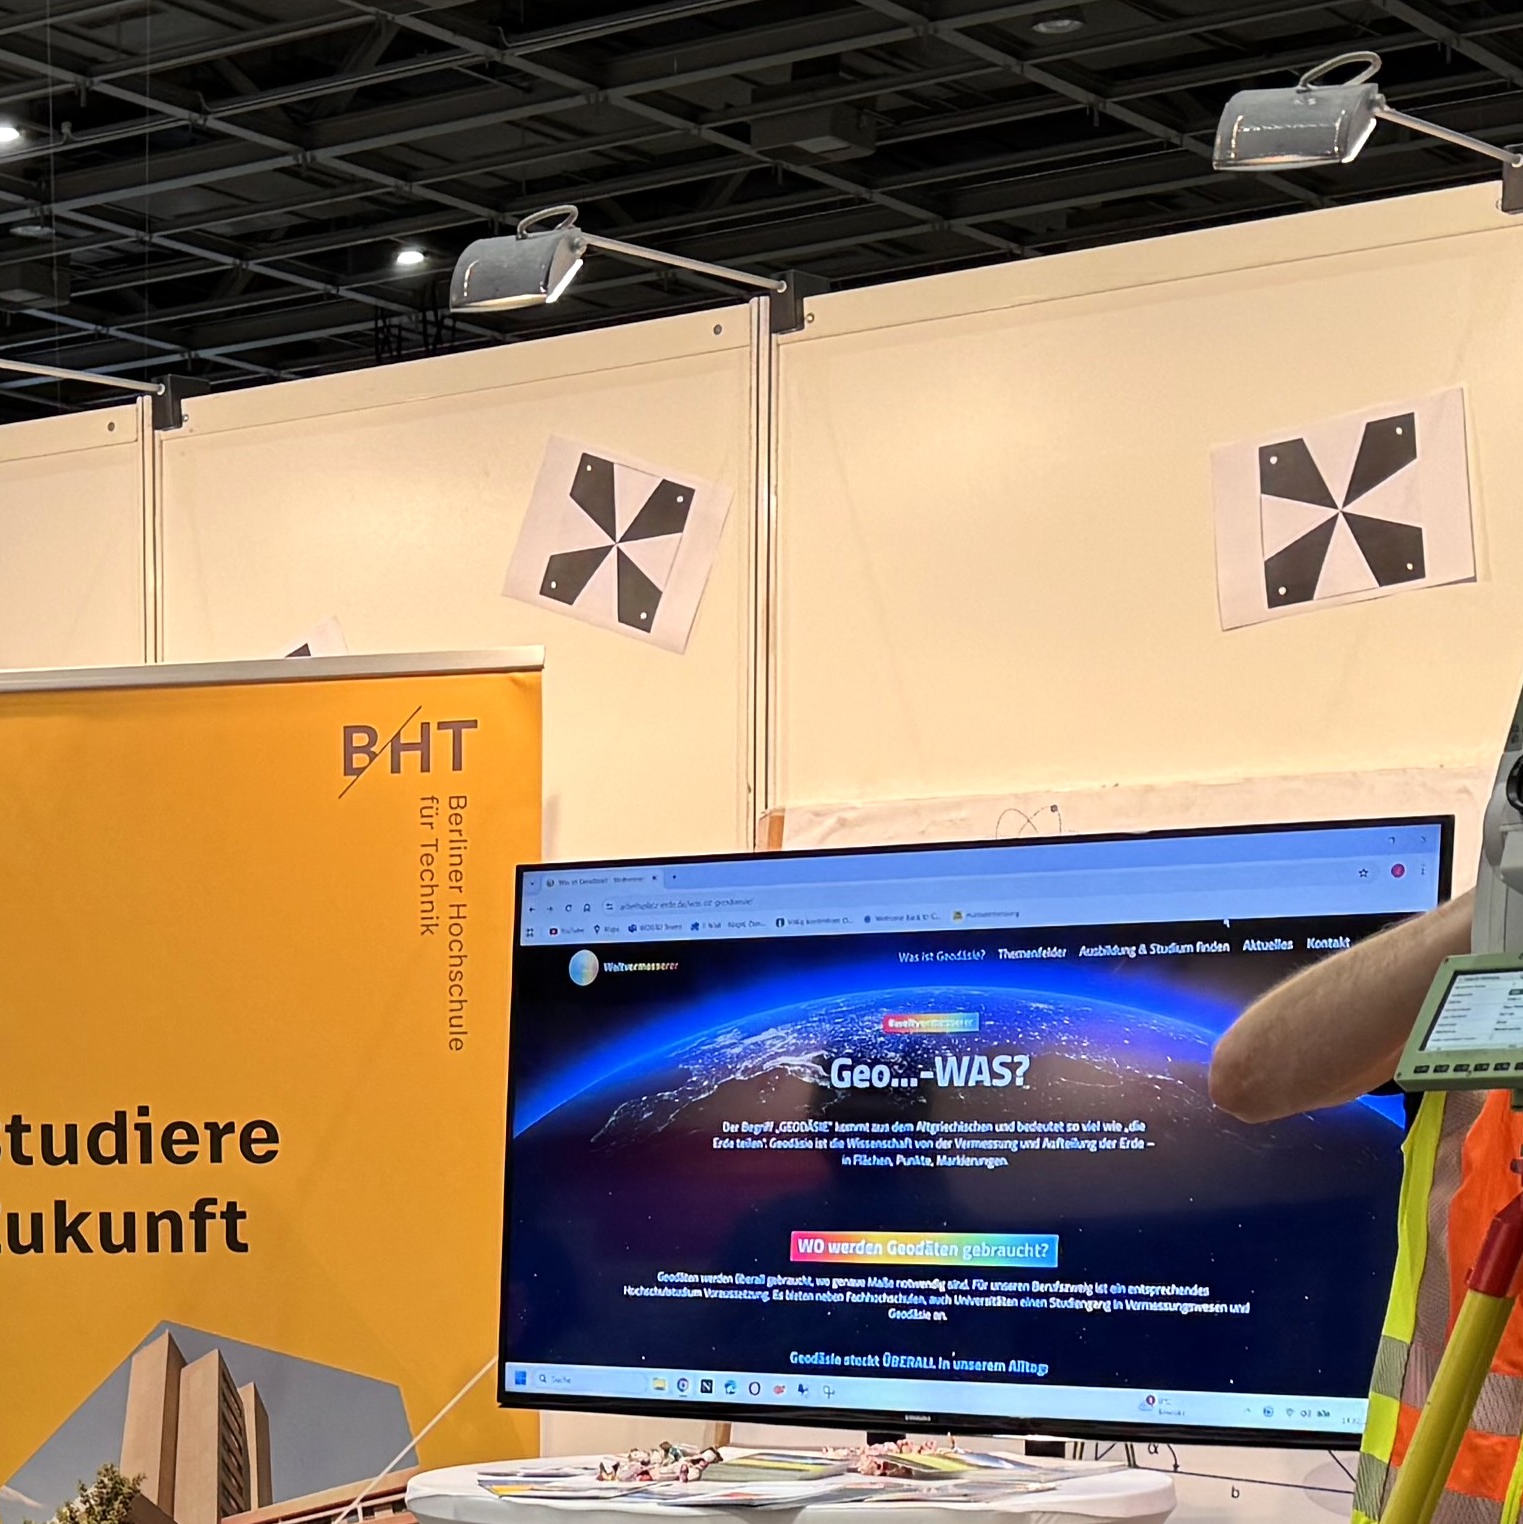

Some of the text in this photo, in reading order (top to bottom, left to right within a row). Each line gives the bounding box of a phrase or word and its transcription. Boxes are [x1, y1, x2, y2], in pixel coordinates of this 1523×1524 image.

[419, 794, 440, 937] für Technik
[447, 794, 469, 1052] Berliner Hochschule
[898, 951, 920, 963] Was
[921, 951, 935, 963] ist
[997, 946, 1067, 960] Themenfelder
[1078, 943, 1137, 959] Ausbildung
[1149, 942, 1195, 956] Studium
[1195, 941, 1231, 954] finden
[1241, 937, 1294, 952] Aktuelles
[1306, 935, 1351, 950] Kontakt
[722, 1121, 740, 1133] Der
[891, 1121, 915, 1133] dem
[994, 1121, 1016, 1133] und
[1016, 1121, 1065, 1133] bedeutet
[1066, 1123, 1080, 1133] so
[1081, 1121, 1101, 1133] viel
[1102, 1121, 1123, 1133] wie
[712, 1137, 735, 1149] Erde
[814, 1138, 828, 1149] ist
[846, 1137, 913, 1150] Wissenschaft
[914, 1140, 934, 1150] von
[935, 1138, 952, 1149] der
[954, 1138, 1019, 1152] Vermessung
[1019, 1138, 1041, 1150] und
[1041, 1138, 1098, 1152] Aufteilung
[1098, 1137, 1117, 1150] der
[1119, 1137, 1145, 1149] Erde
[841, 1153, 853, 1166] in
[797, 1238, 1050, 1261] WO werden Geodäten gebraucht?
[700, 1272, 734, 1284] werden
[895, 1278, 946, 1292] notwendig
[971, 1278, 989, 1291] Für
[990, 1281, 1030, 1292] unseren
[1109, 1283, 1126, 1295] ein
[1127, 1283, 1210, 1298] entsprechendes
[772, 1288, 784, 1300] Es
[953, 1294, 1019, 1307] Universitäten
[1019, 1297, 1048, 1308] einen
[1048, 1297, 1112, 1312] Studiengang
[1112, 1298, 1124, 1311] in
[1125, 1299, 1228, 1315] Vermessungswesen
[1229, 1301, 1251, 1314] und
[789, 1351, 842, 1366] Geodäsie
[843, 1354, 880, 1367] steckt
[952, 1359, 1006, 1373] unserem
[1231, 1486, 1241, 1499] b
